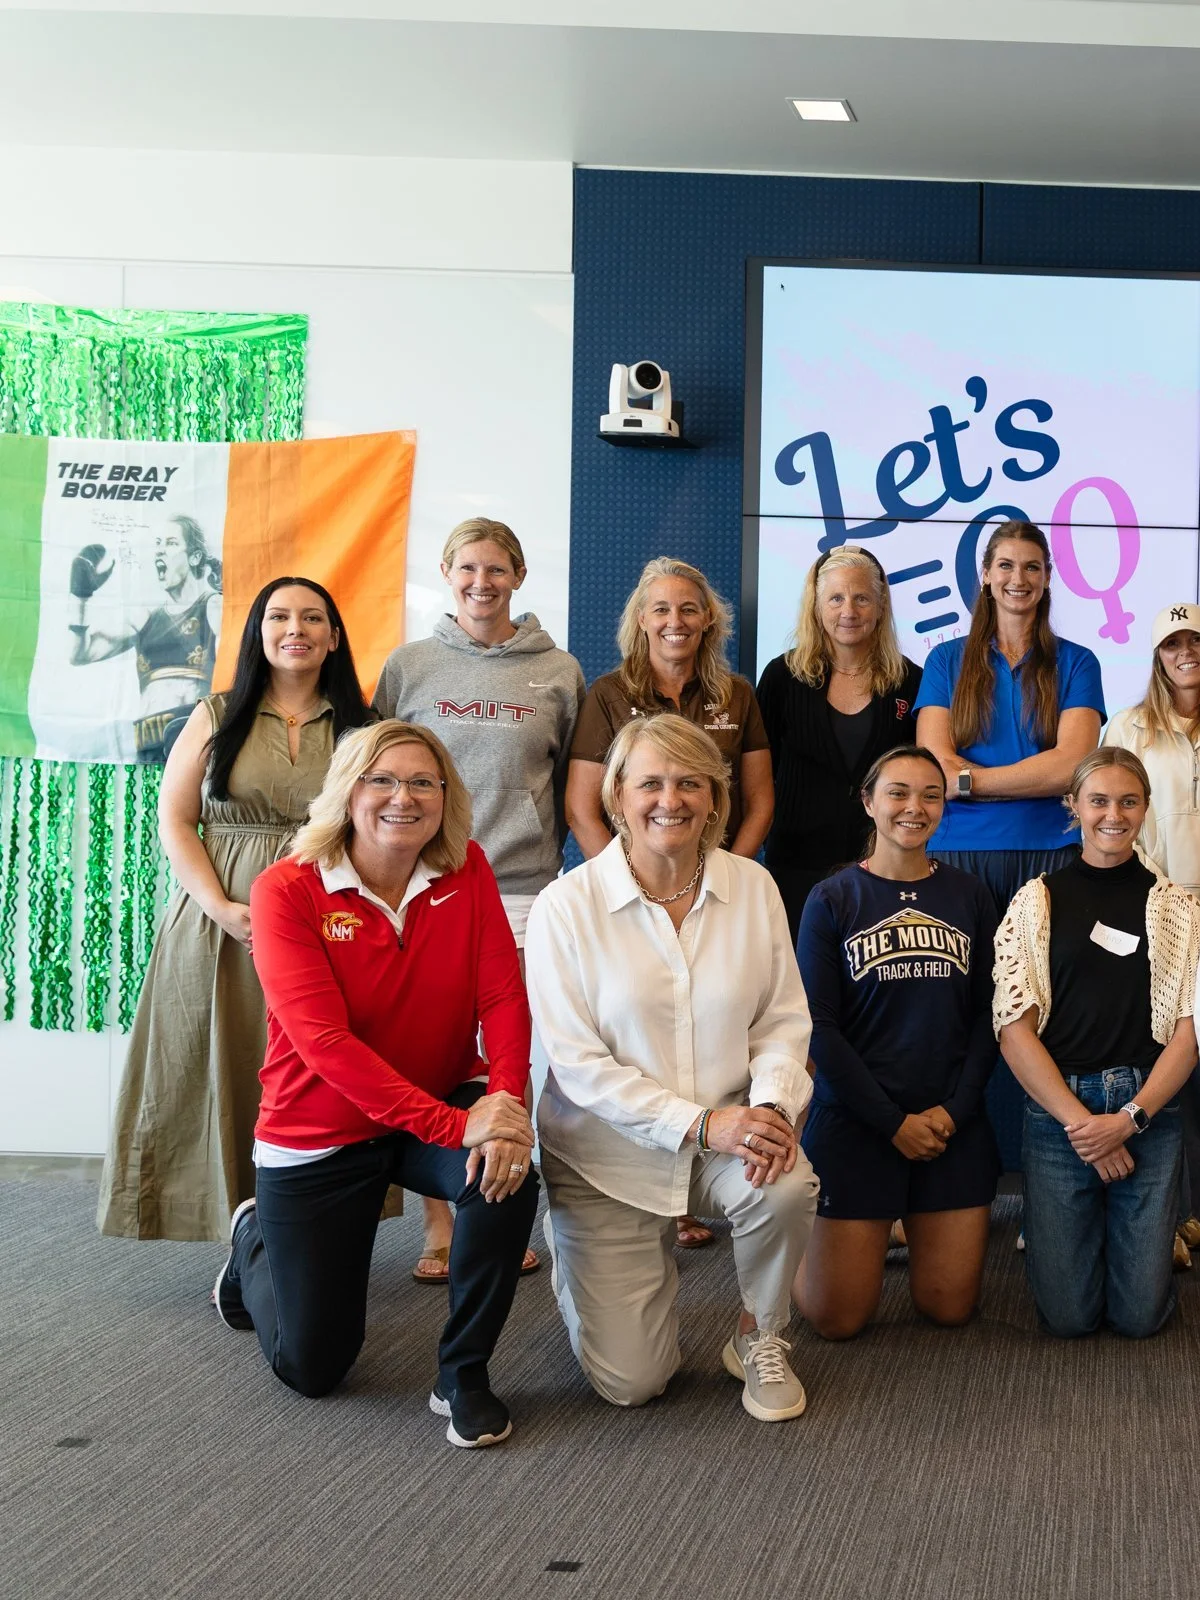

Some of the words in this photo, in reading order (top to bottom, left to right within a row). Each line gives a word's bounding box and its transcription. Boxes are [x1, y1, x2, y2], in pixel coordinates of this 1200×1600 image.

[58, 462, 104, 480] THE
[107, 465, 179, 483] BRAY
[775, 376, 1060, 554] Let's
[61, 481, 167, 502] BOMBER
[1170, 606, 1188, 621] NY
[435, 700, 536, 722] MIT
[332, 923, 352, 940] NM
[849, 929, 893, 971] THE
[896, 926, 969, 965] MOUNT
[876, 962, 912, 981] TRACK
[913, 963, 923, 978] &
[924, 961, 951, 978] FIELD
